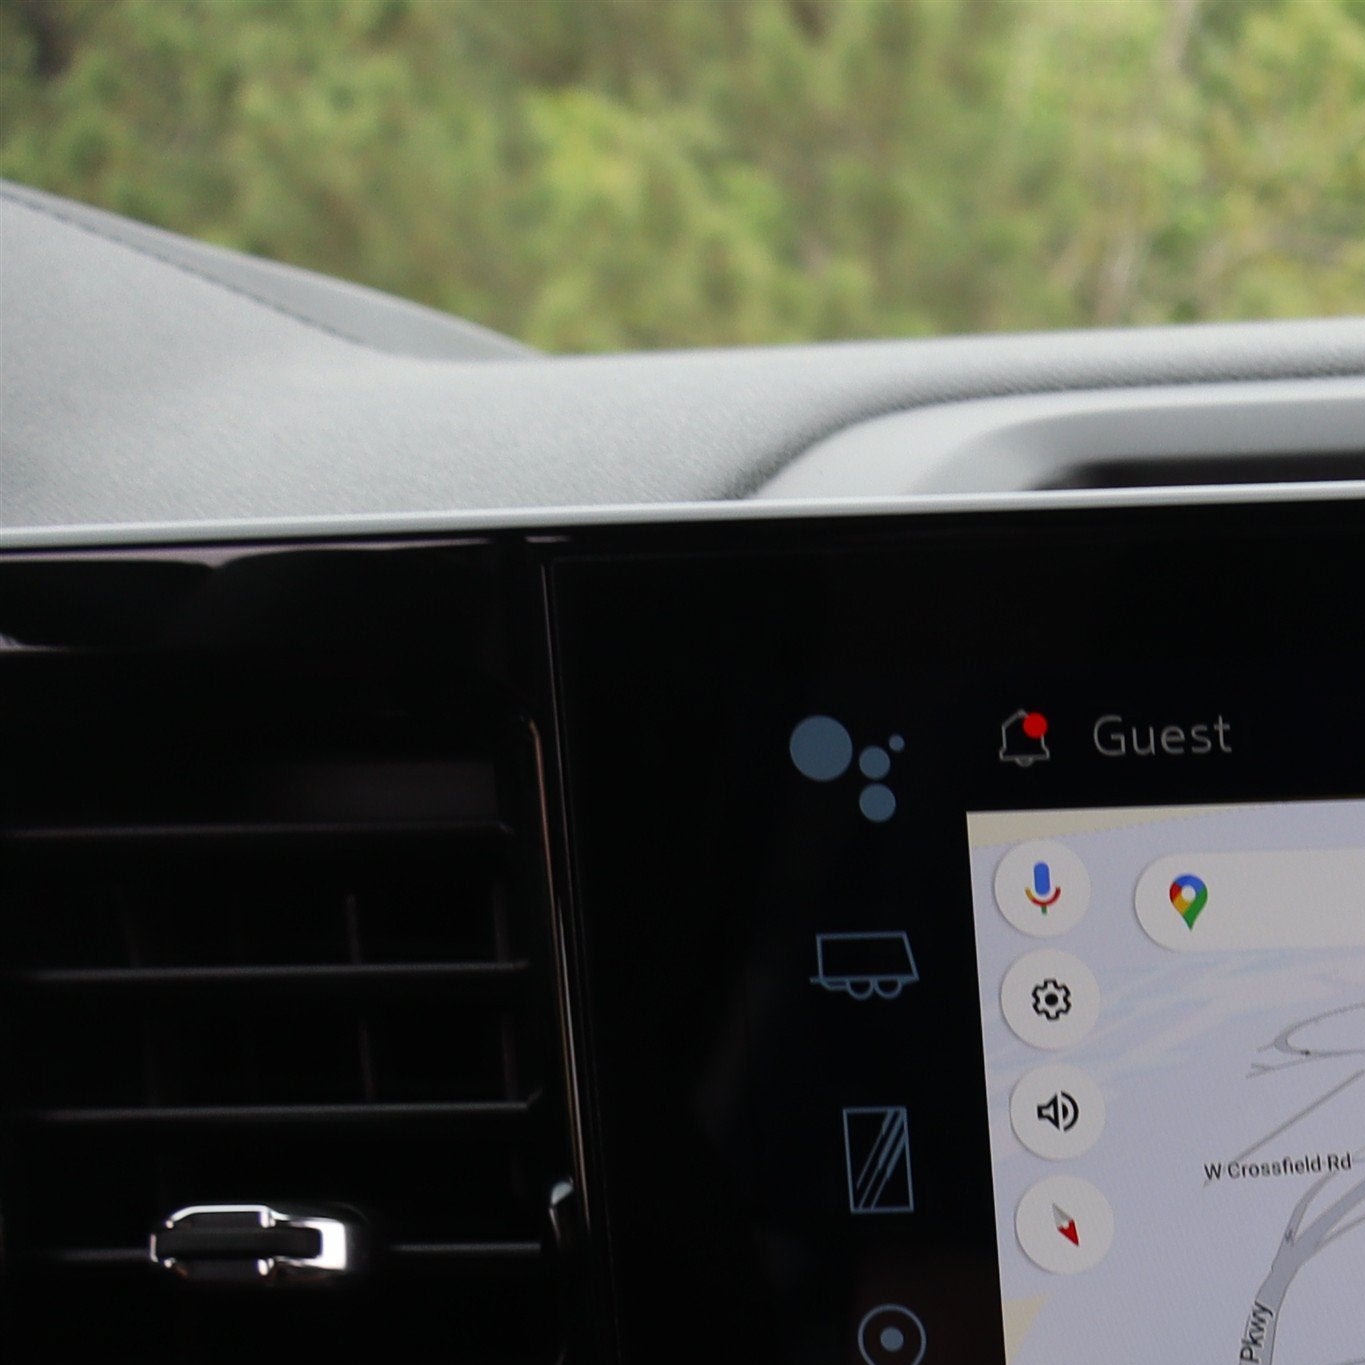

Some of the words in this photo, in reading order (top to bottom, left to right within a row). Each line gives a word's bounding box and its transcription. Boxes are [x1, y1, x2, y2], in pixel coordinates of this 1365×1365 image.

[1092, 713, 1233, 756] Guest
[1203, 1162, 1222, 1181] W
[1227, 1155, 1322, 1179] Crossfield
[1328, 1152, 1352, 1172] Rd
[1239, 1300, 1275, 1363] Pkwy
